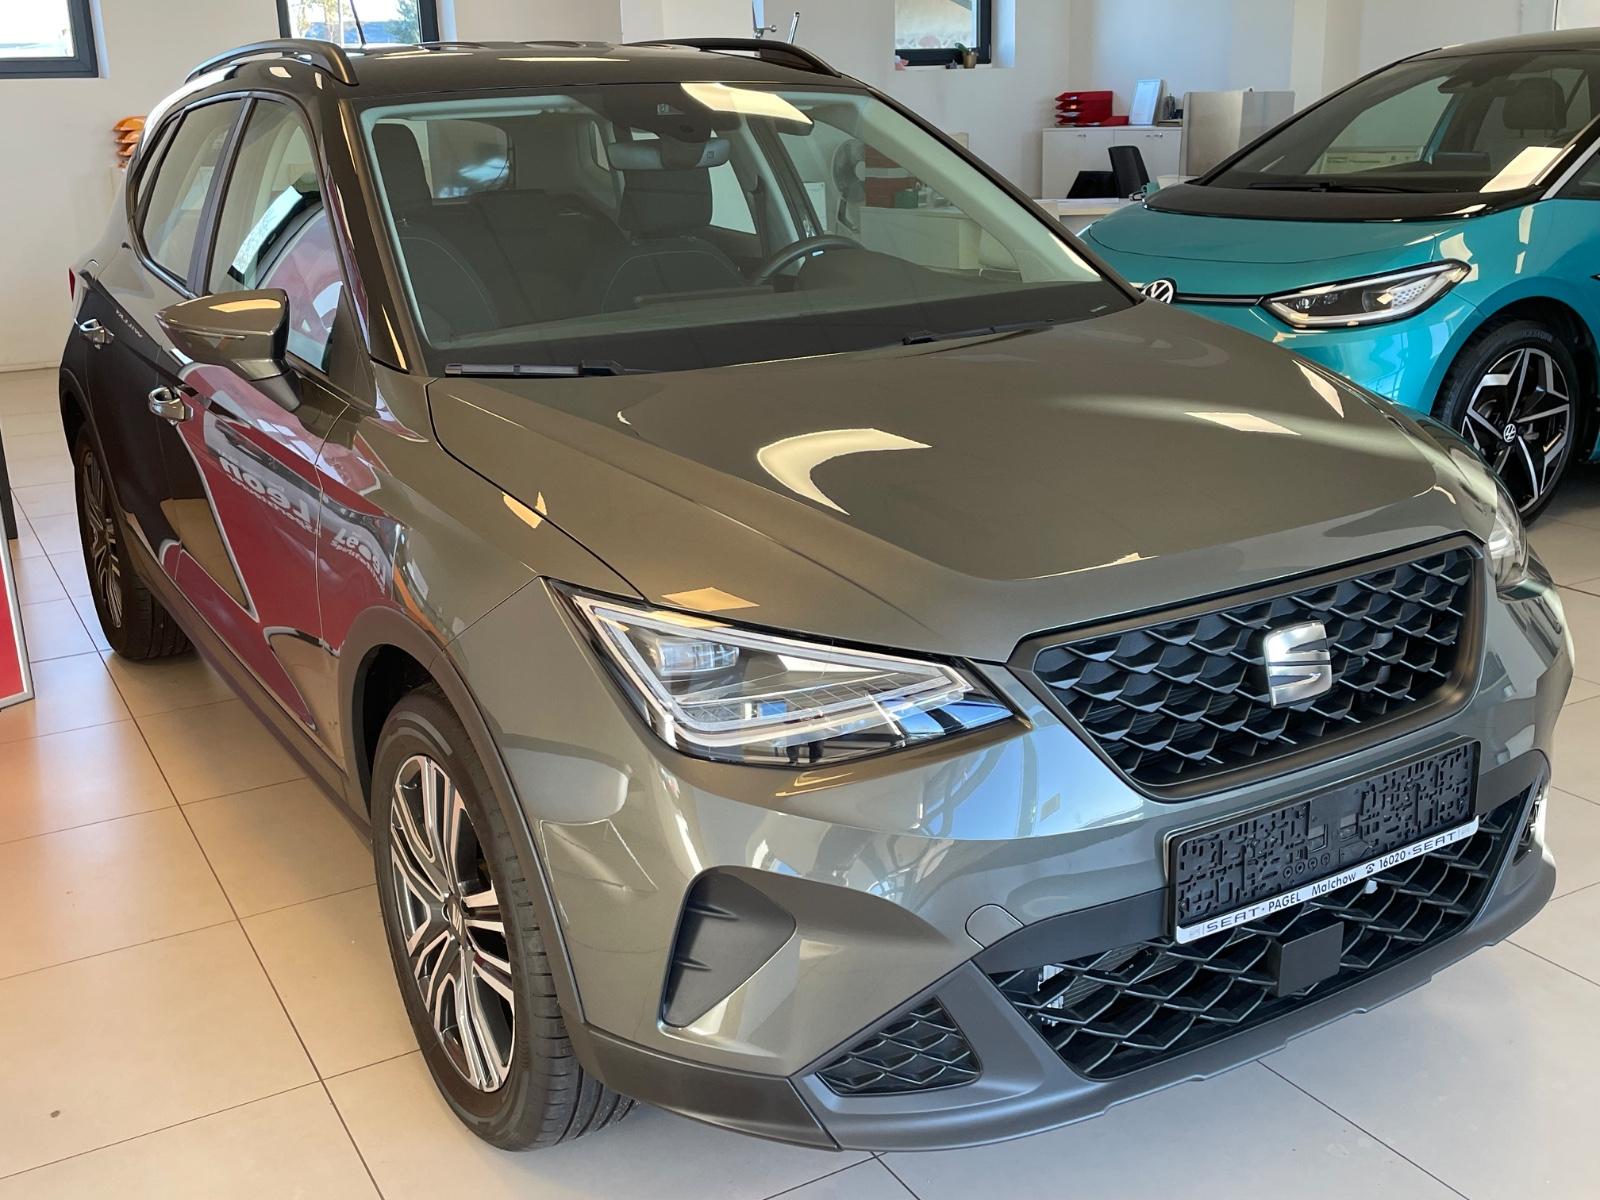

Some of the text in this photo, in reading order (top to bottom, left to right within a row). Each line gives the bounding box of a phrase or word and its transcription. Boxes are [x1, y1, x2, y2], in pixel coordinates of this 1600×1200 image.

[1207, 832, 1455, 932] SEAT PAGEL Malchow 16020 SEAT
